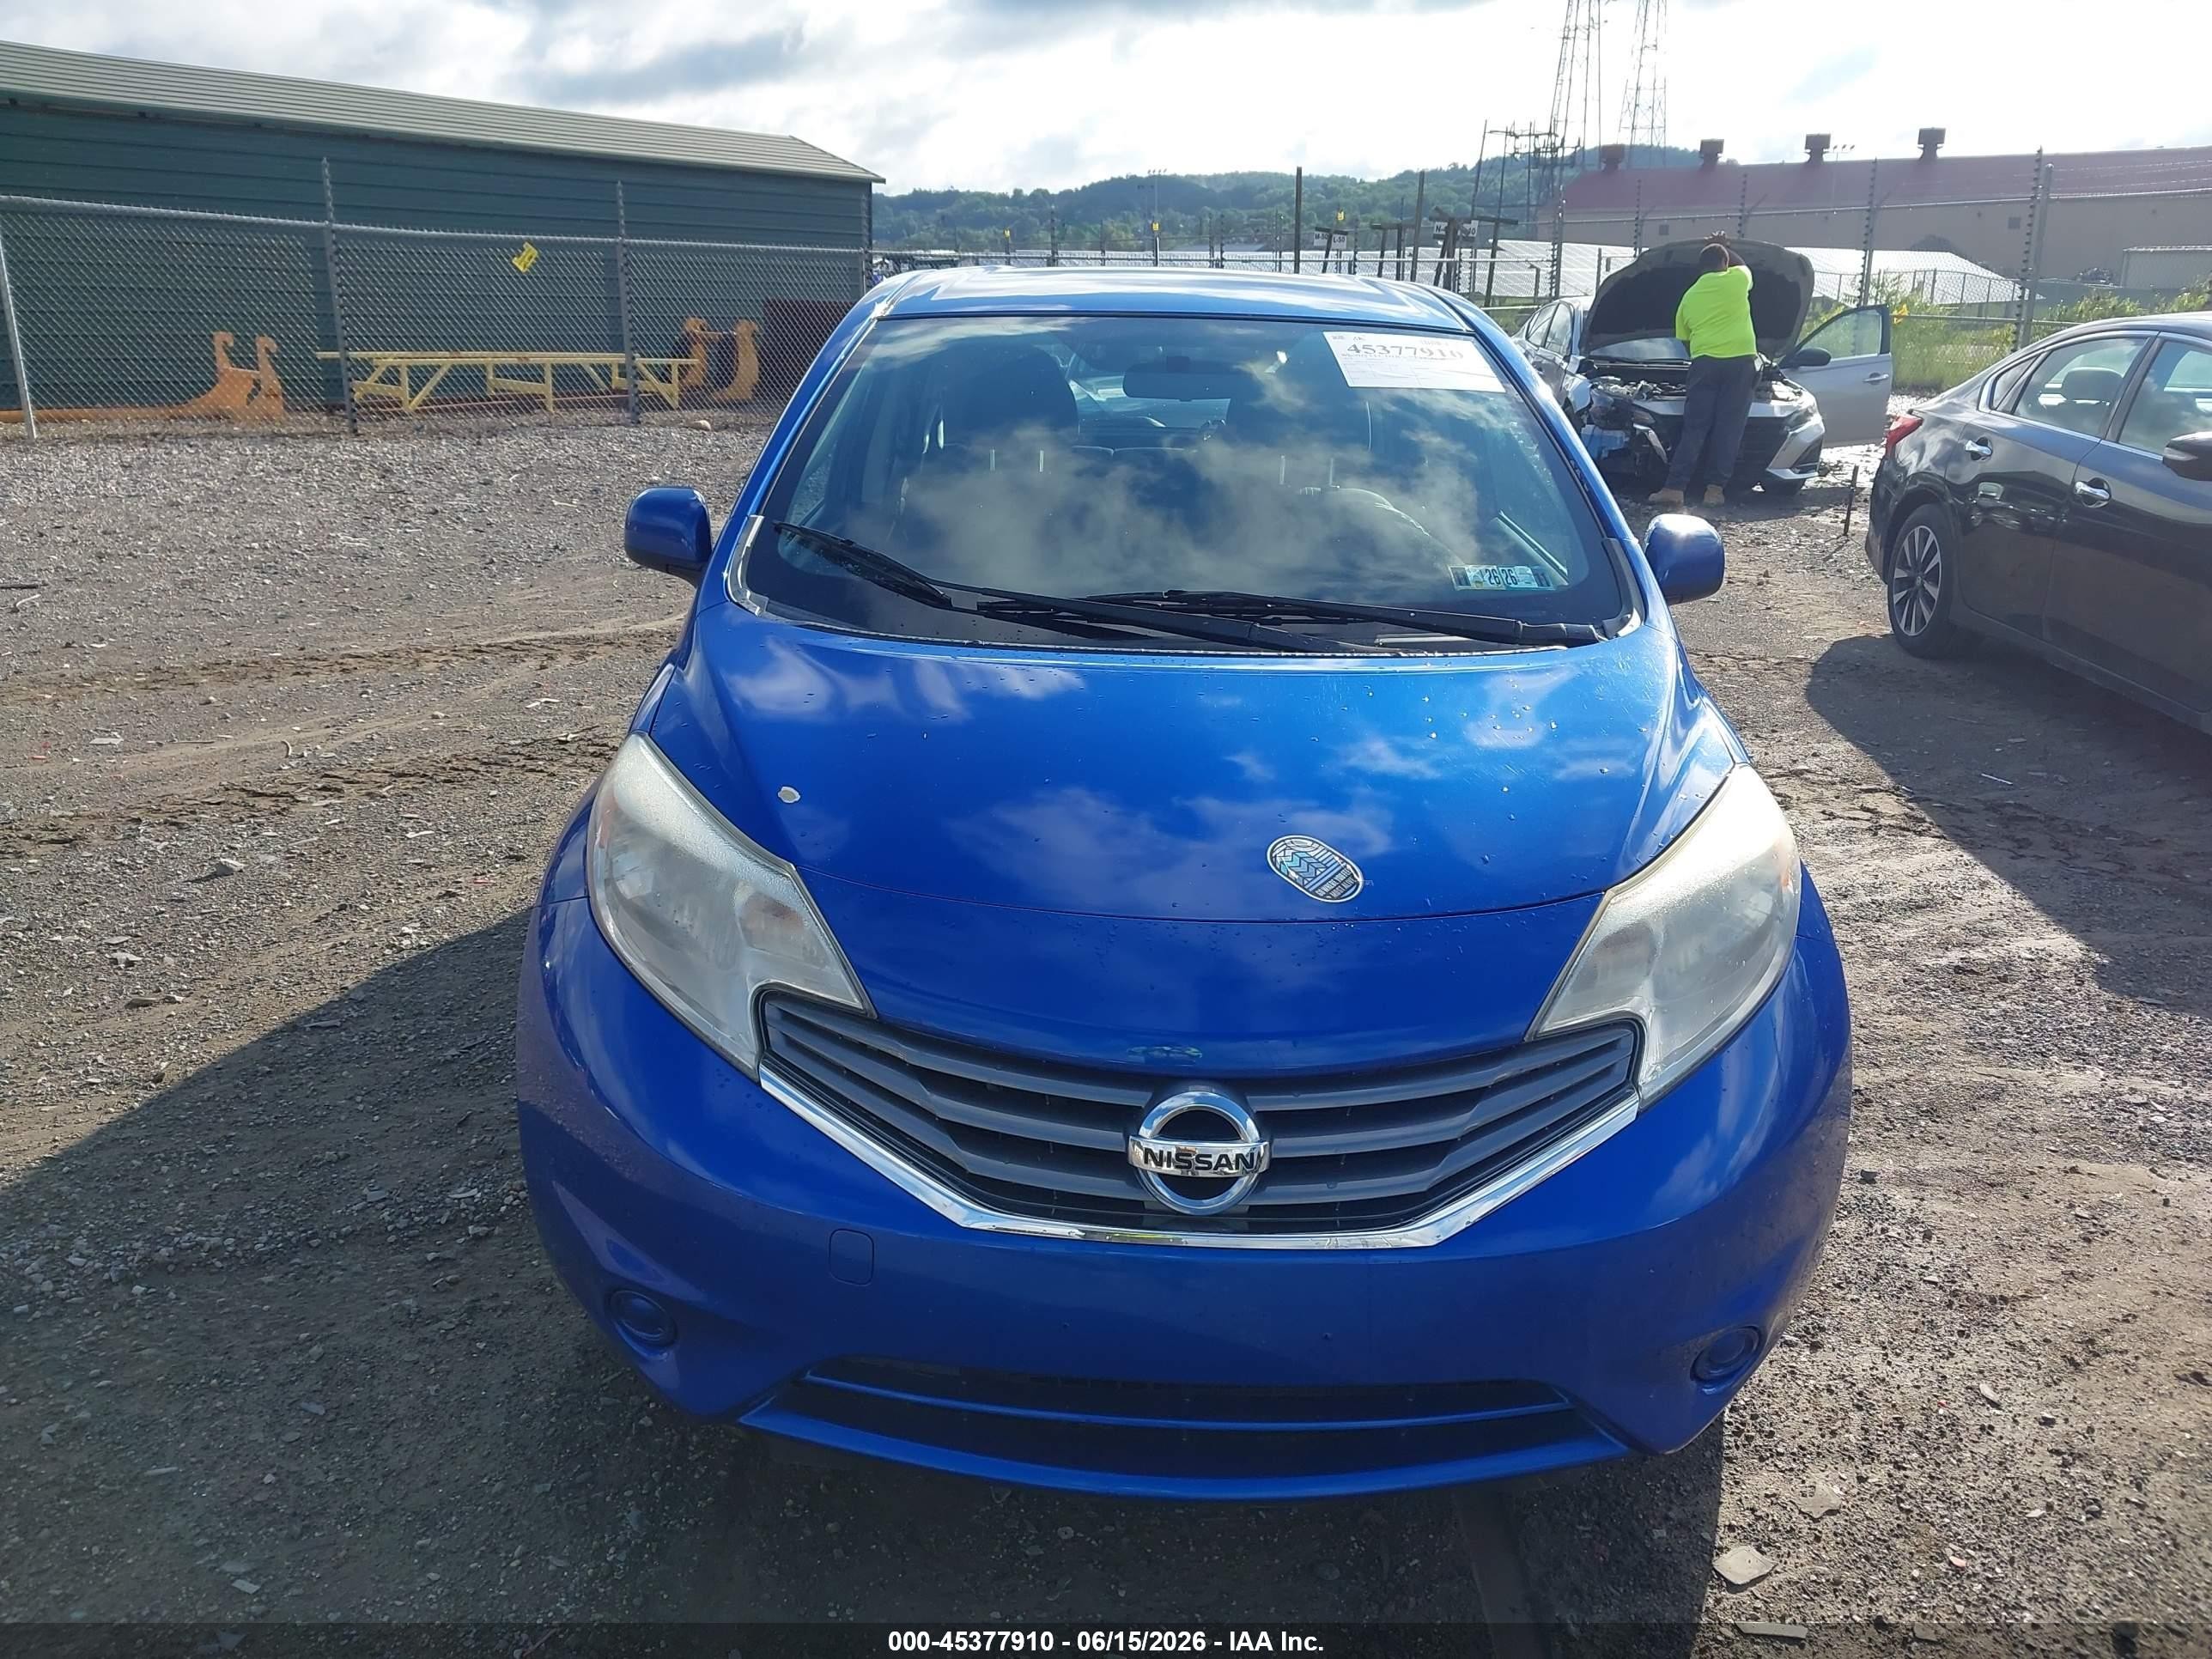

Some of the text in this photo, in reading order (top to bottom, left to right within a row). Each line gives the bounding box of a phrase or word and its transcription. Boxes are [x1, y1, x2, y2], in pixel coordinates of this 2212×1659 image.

[1346, 343, 1464, 360] 45377910
[1485, 568, 1501, 586] 26
[1500, 568, 1518, 586] 26
[1143, 1147, 1255, 1171] NISSAN
